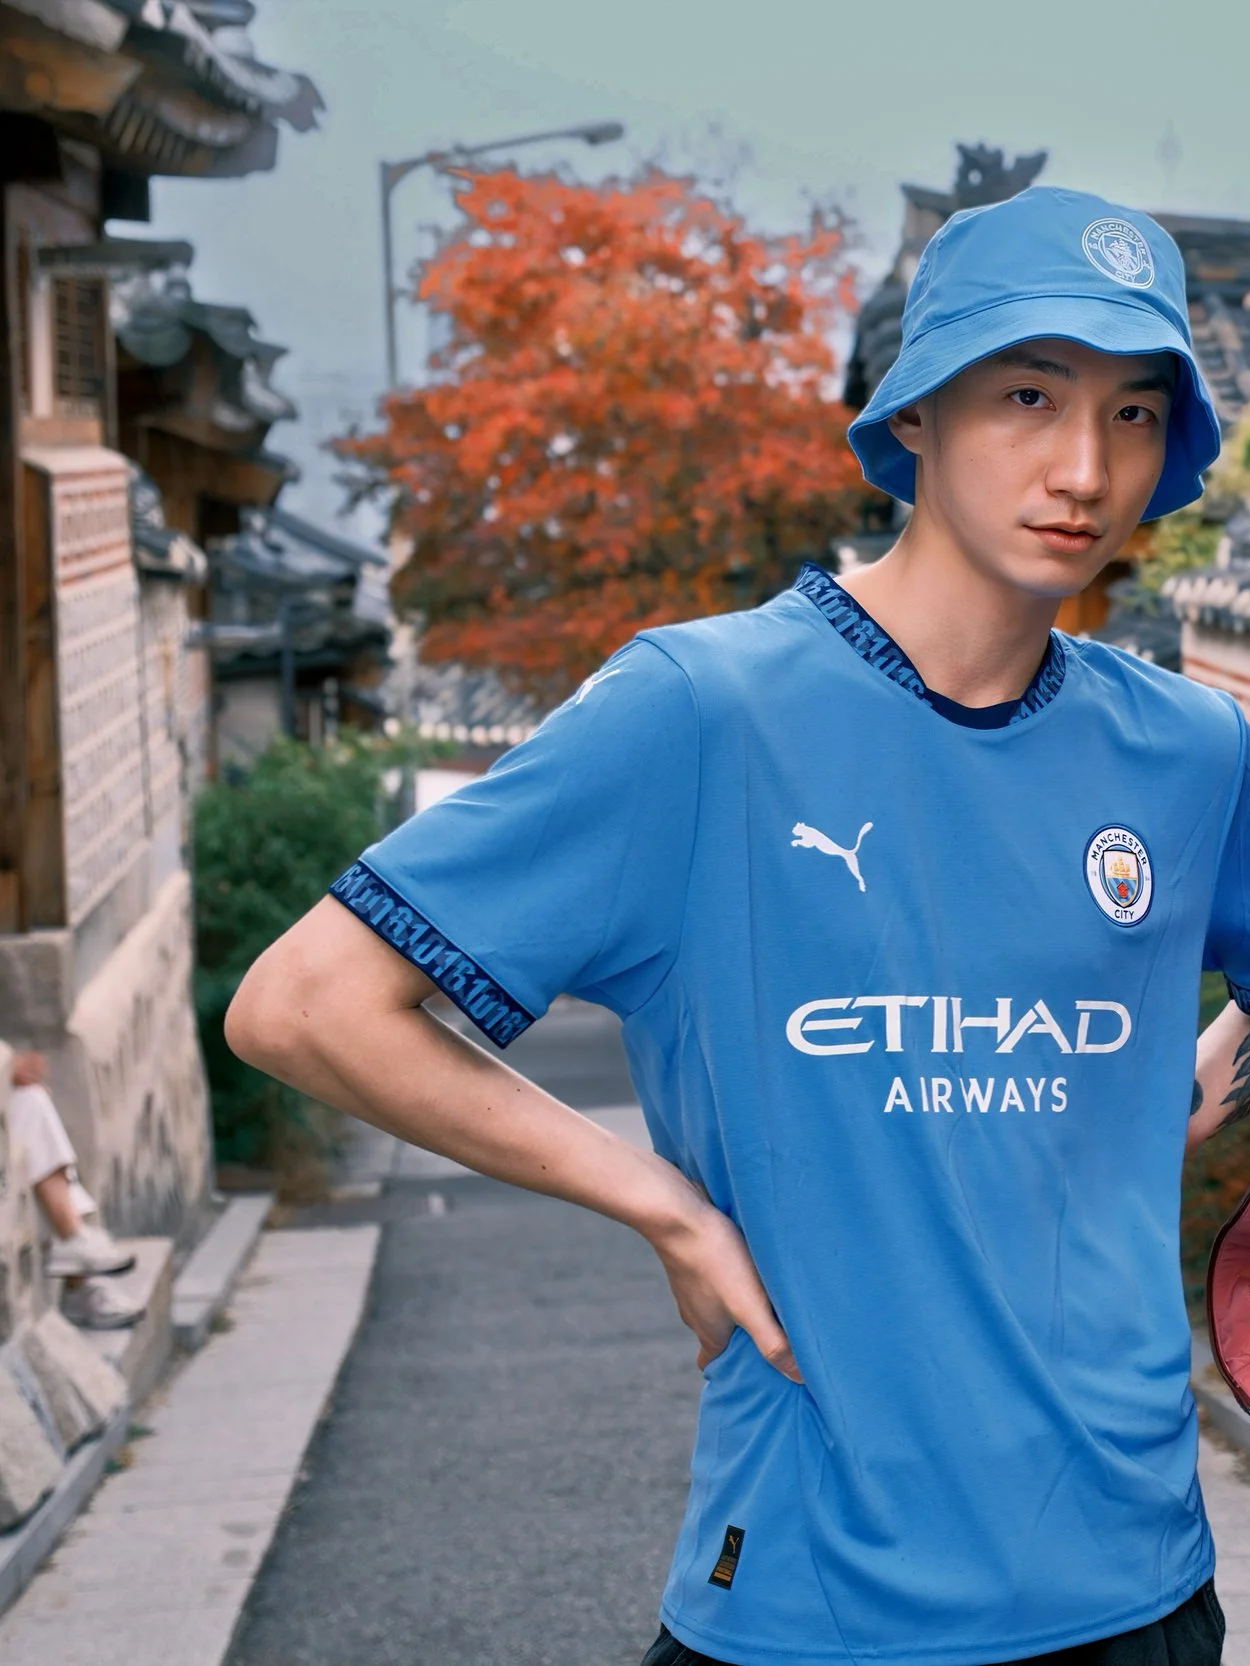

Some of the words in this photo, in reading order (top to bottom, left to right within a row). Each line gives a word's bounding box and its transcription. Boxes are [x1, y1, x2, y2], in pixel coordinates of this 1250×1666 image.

[1115, 270, 1136, 283] CITY
[1091, 832, 1148, 866] MANCHESTER
[1114, 909, 1135, 920] CITY
[786, 995, 1132, 1056] ETIHAD
[883, 1076, 1068, 1113] AIRWAYS
